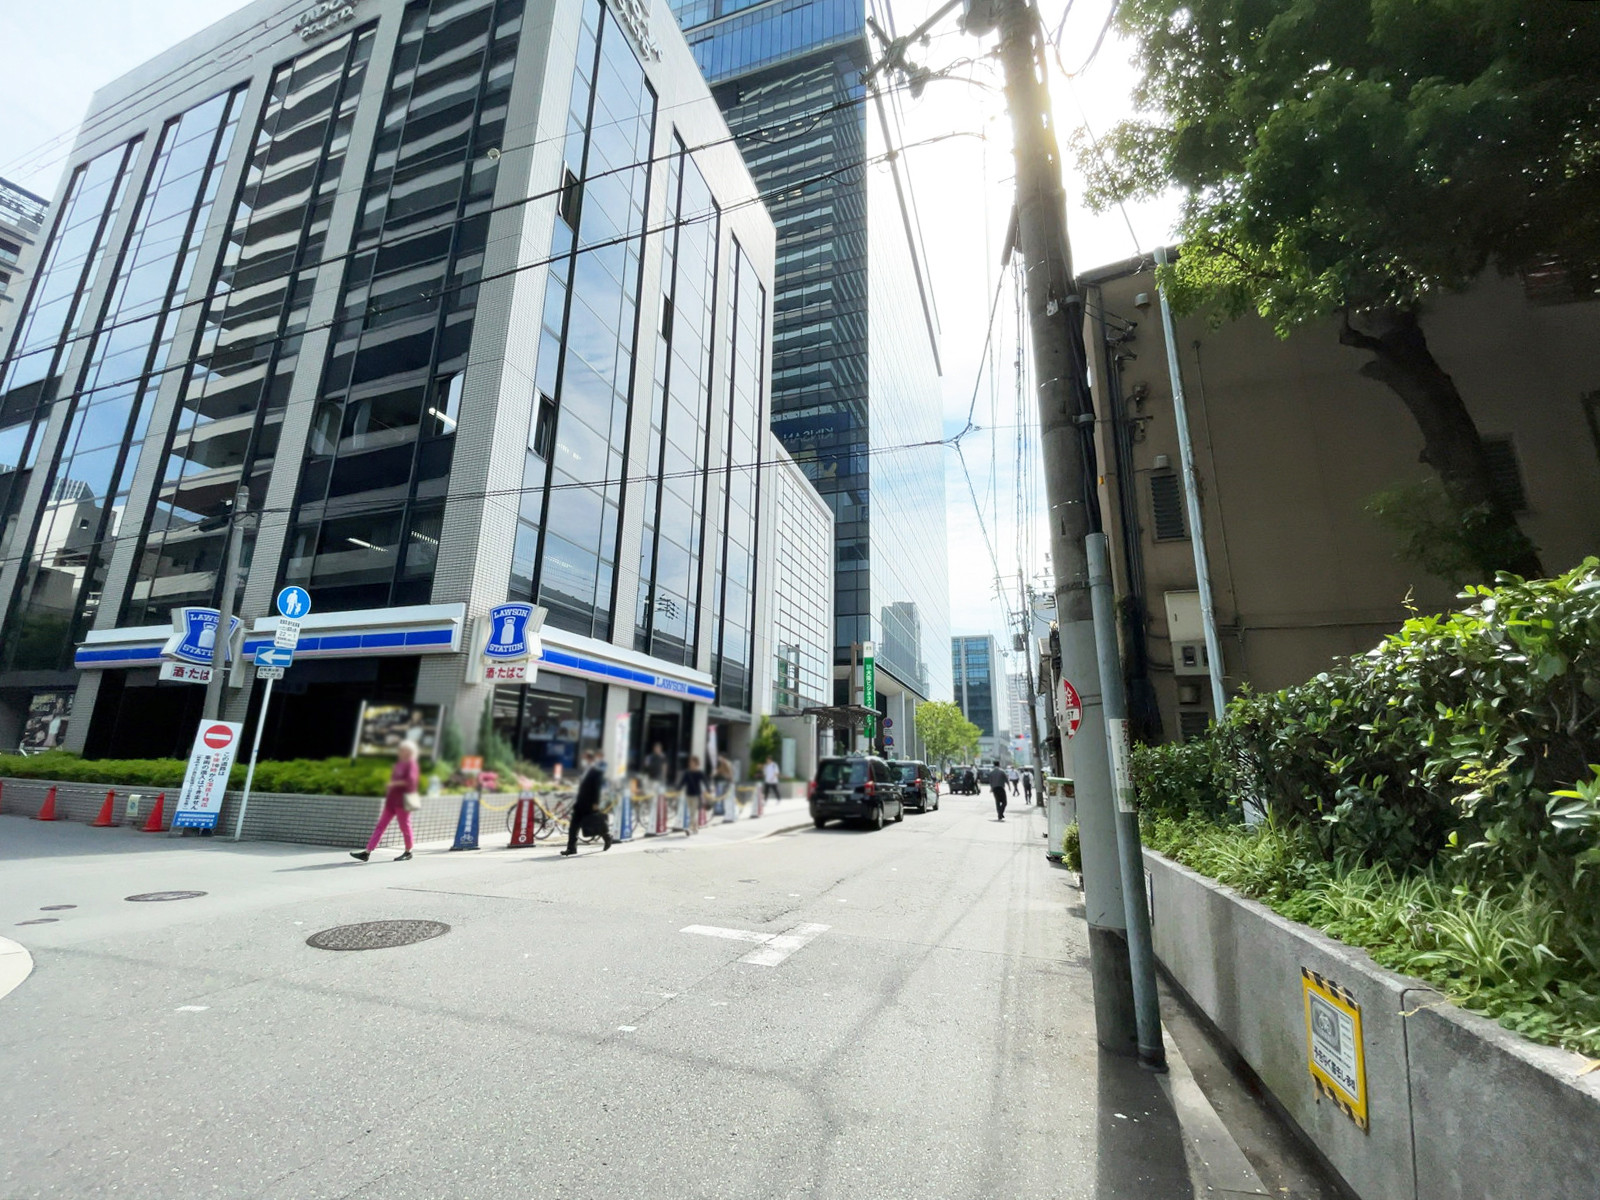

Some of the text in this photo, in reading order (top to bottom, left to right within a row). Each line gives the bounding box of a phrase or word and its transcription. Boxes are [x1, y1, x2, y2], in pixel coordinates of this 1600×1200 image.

[190, 614, 220, 623] LAWS
[494, 608, 529, 618] LAWSON
[182, 644, 214, 656] STATI
[488, 642, 524, 653] STATION
[486, 667, 525, 679] 酒・たばこ
[656, 677, 687, 693] LAWSON
